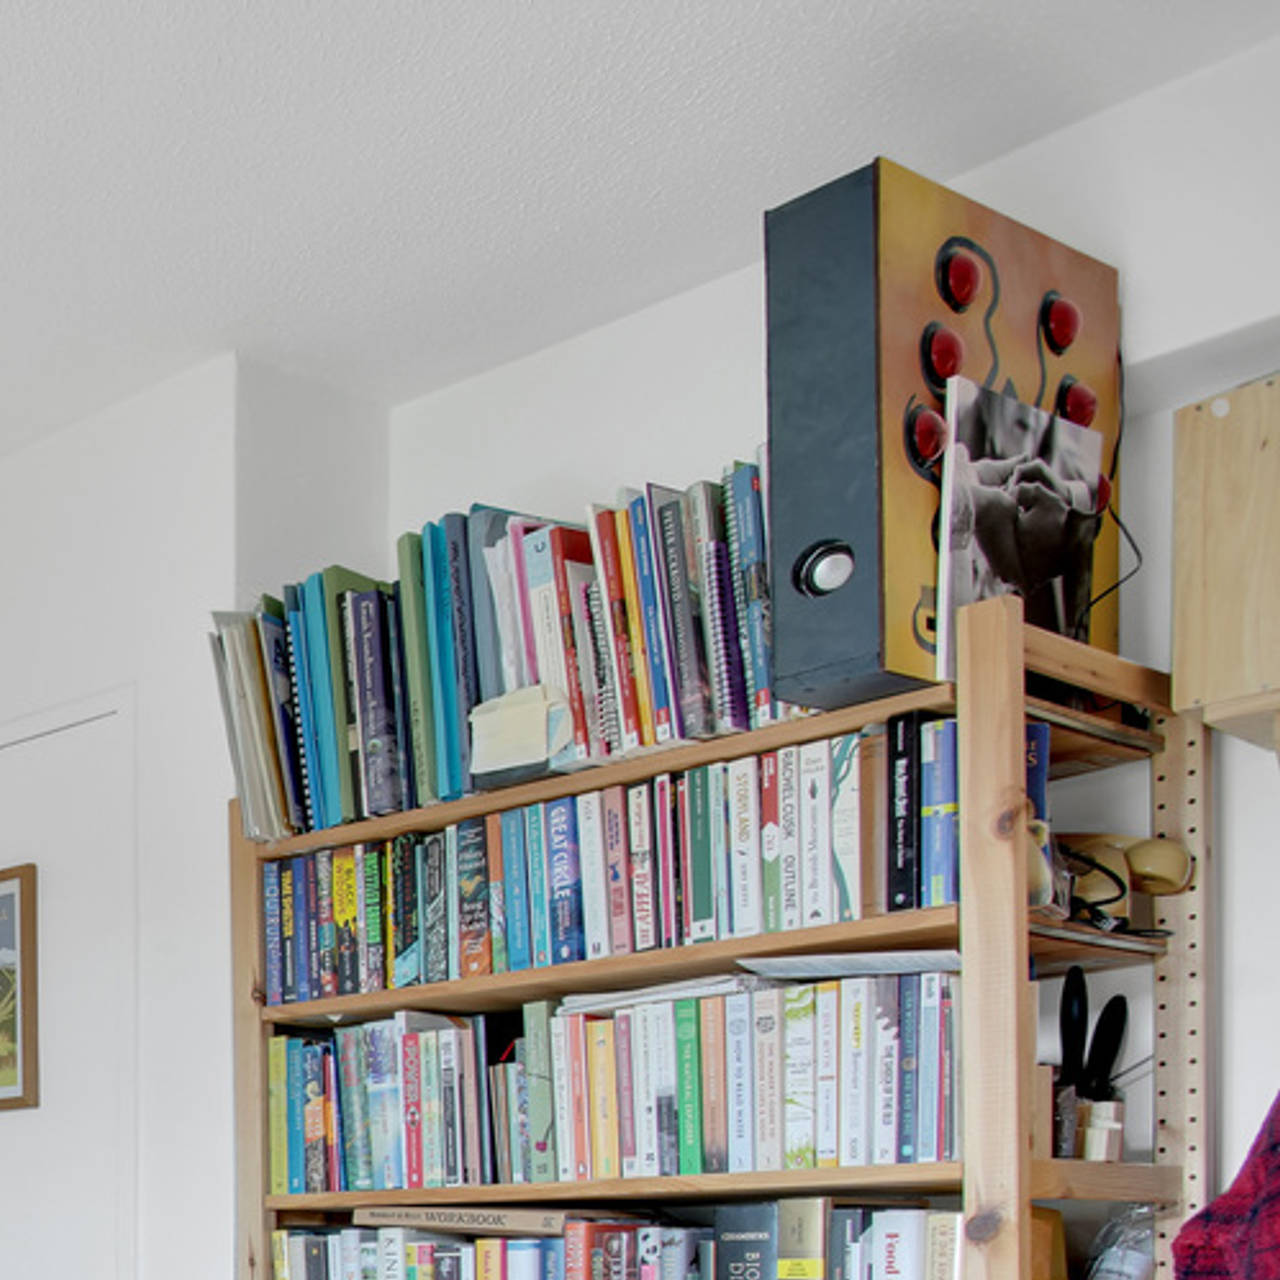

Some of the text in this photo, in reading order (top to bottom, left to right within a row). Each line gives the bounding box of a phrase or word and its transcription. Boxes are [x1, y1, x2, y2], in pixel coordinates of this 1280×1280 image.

[551, 806, 569, 849] GREAT
[553, 852, 572, 899] CIRCLE
[783, 855, 797, 911] OUTLINE
[424, 1211, 507, 1227] WORKBOOK
[885, 1232, 901, 1275] Food
